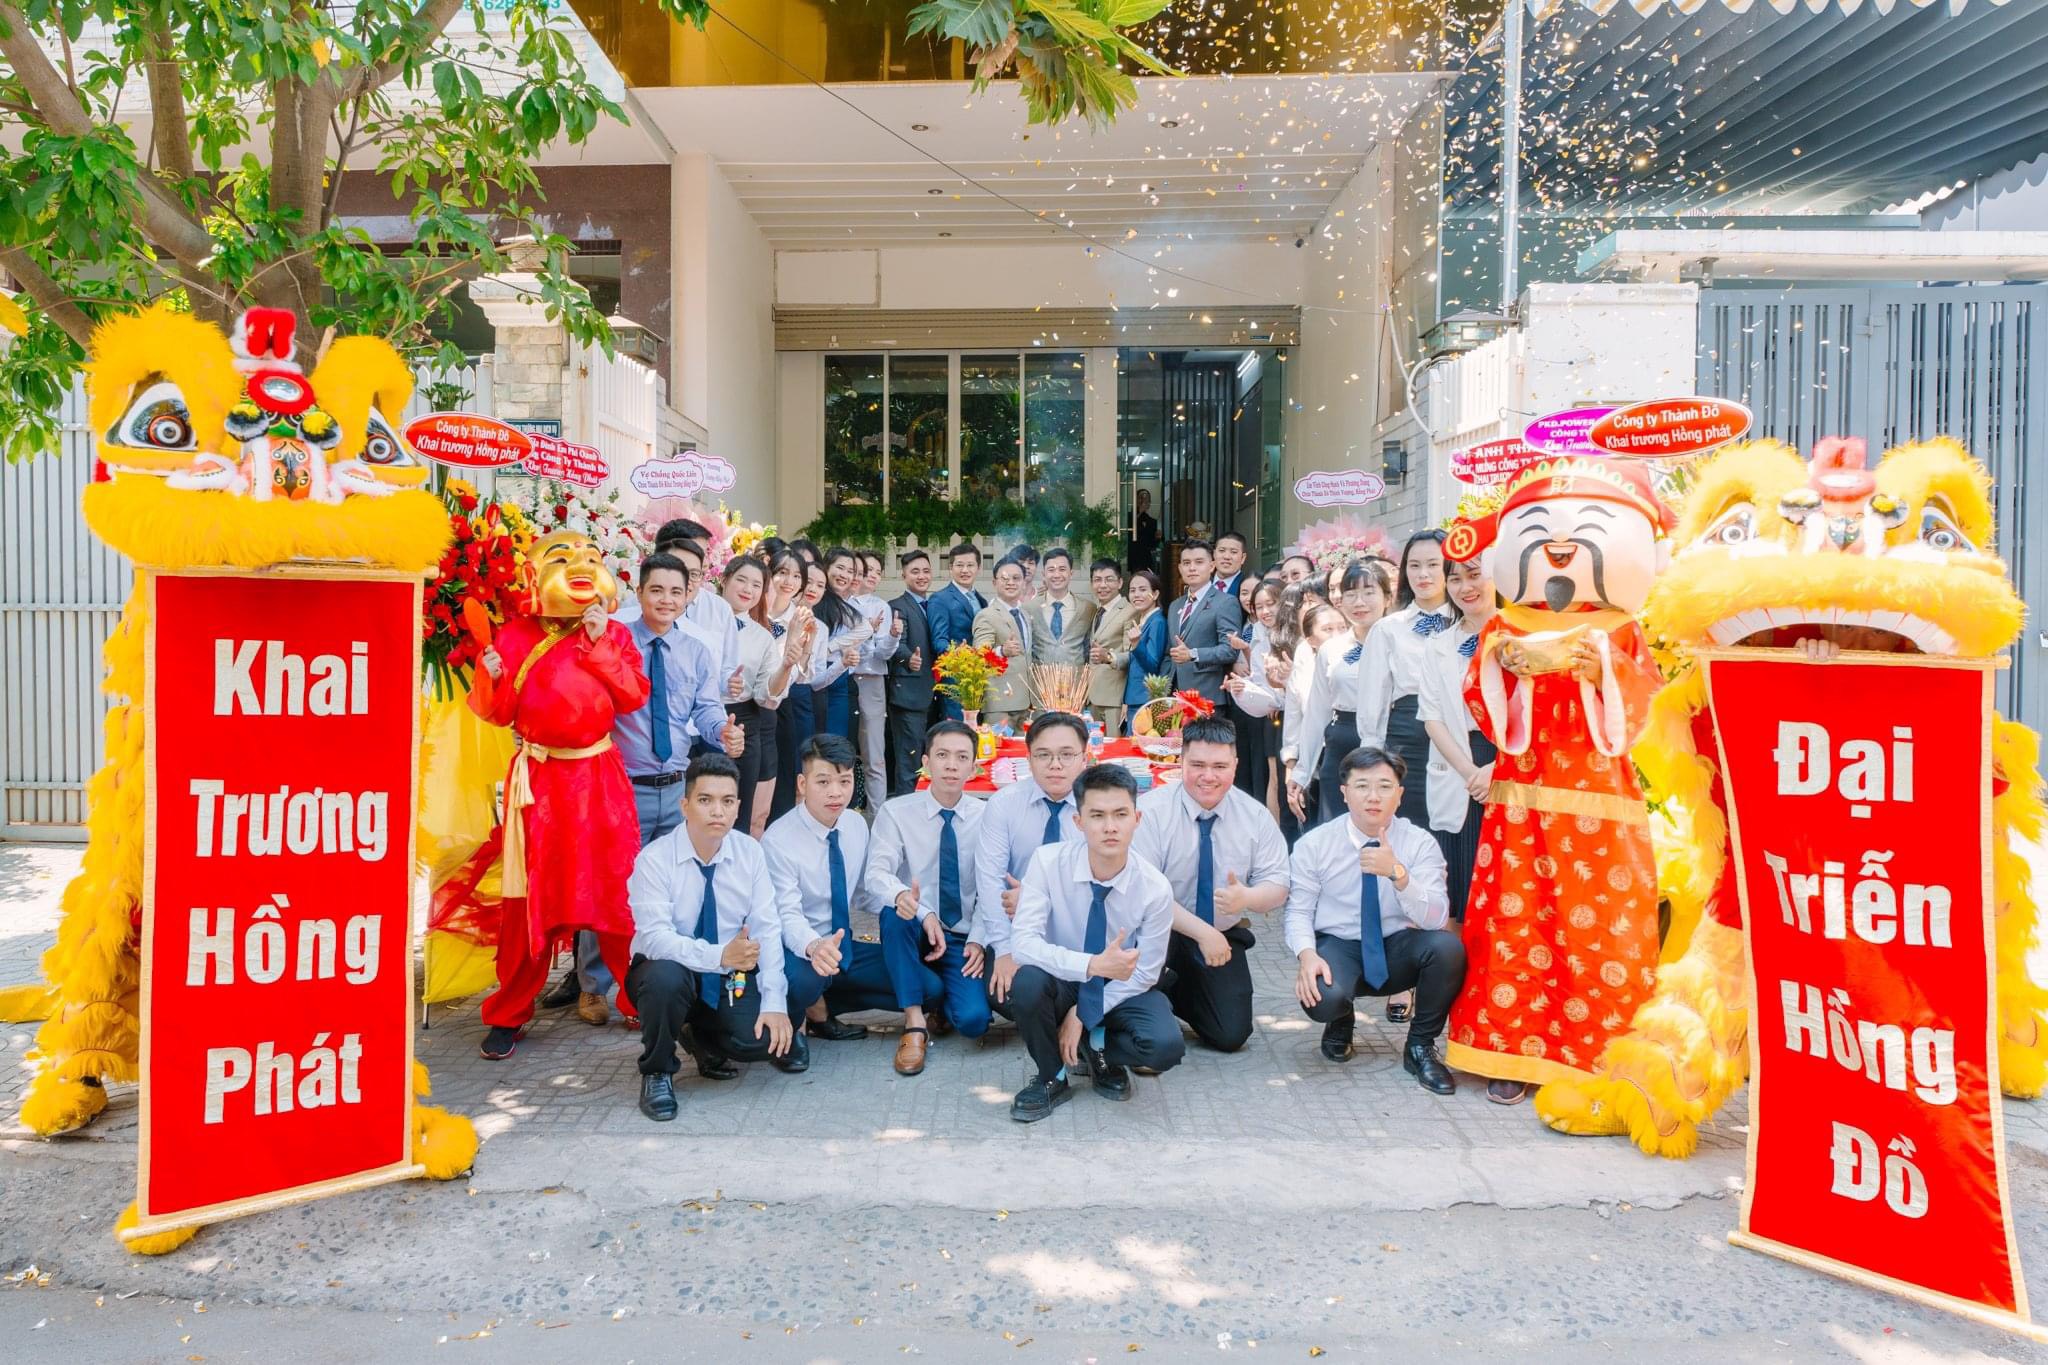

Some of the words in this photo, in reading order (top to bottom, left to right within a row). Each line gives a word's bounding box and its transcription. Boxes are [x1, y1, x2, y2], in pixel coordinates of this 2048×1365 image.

[416, 434, 439, 450] Khai
[441, 439, 473, 459] trương
[475, 440, 498, 462] Hồng
[499, 446, 520, 462] phát
[436, 420, 459, 438] Công
[461, 426, 469, 438] ty
[471, 425, 496, 440] Thành
[1550, 428, 1578, 438] CÔNG
[1605, 433, 1630, 449] Khai
[1632, 432, 1670, 449] trương
[1672, 425, 1701, 444] Hồng
[1705, 424, 1732, 441] phát
[1613, 414, 1643, 429] Công
[1646, 412, 1657, 427] ty
[1660, 407, 1699, 423] Thành
[541, 451, 561, 465] Công
[564, 455, 572, 467] Ty
[574, 458, 596, 471] Thành
[213, 638, 370, 717] Khai
[1771, 720, 1914, 819] Đại
[189, 778, 389, 863] Trương
[186, 893, 383, 986] Hồng
[1763, 848, 1953, 950] Triễn
[203, 1032, 364, 1125] Phát
[1778, 978, 1959, 1107] Hồng
[1830, 1120, 1929, 1219] Đồ
